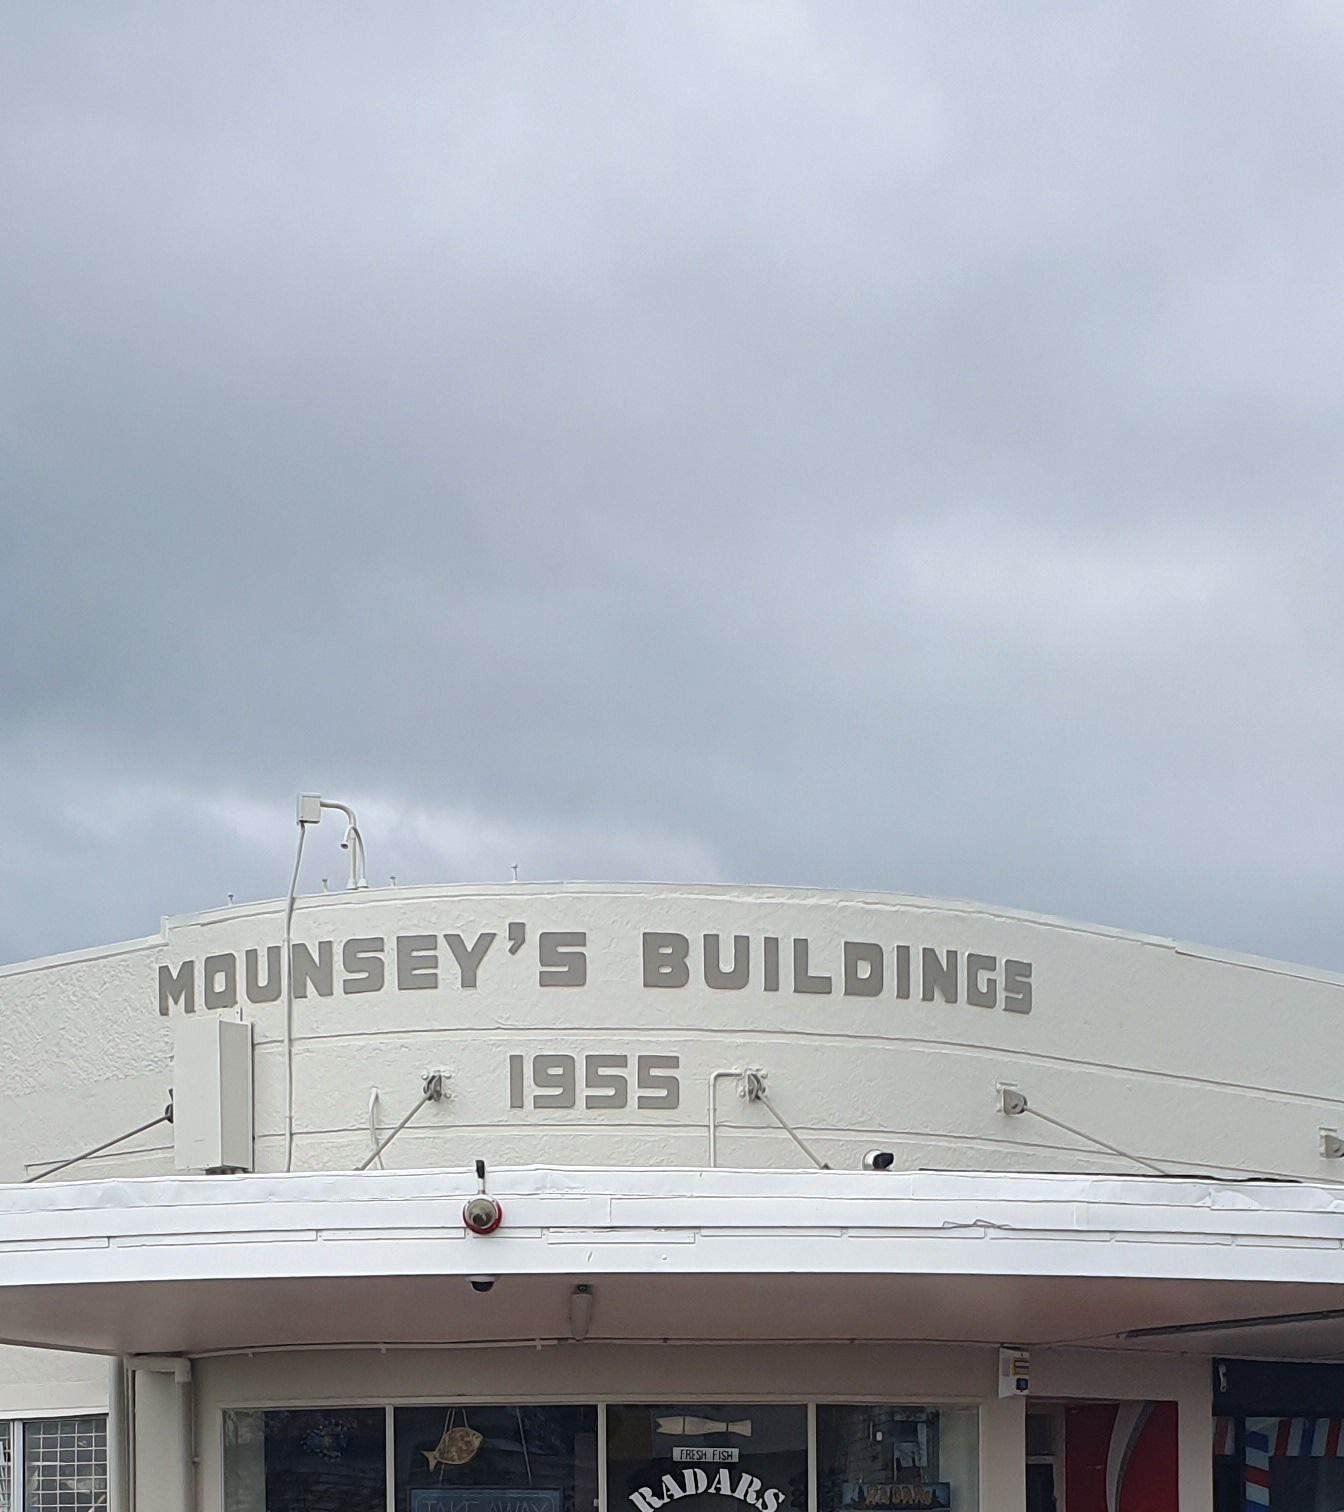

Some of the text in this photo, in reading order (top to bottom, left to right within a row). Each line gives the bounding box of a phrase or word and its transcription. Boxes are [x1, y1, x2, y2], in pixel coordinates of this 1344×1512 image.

[158, 922, 1034, 1017] MOUNSEY'S BUILDINGS
[509, 1053, 681, 1111] 1955
[679, 1448, 734, 1462] FRESH FISH
